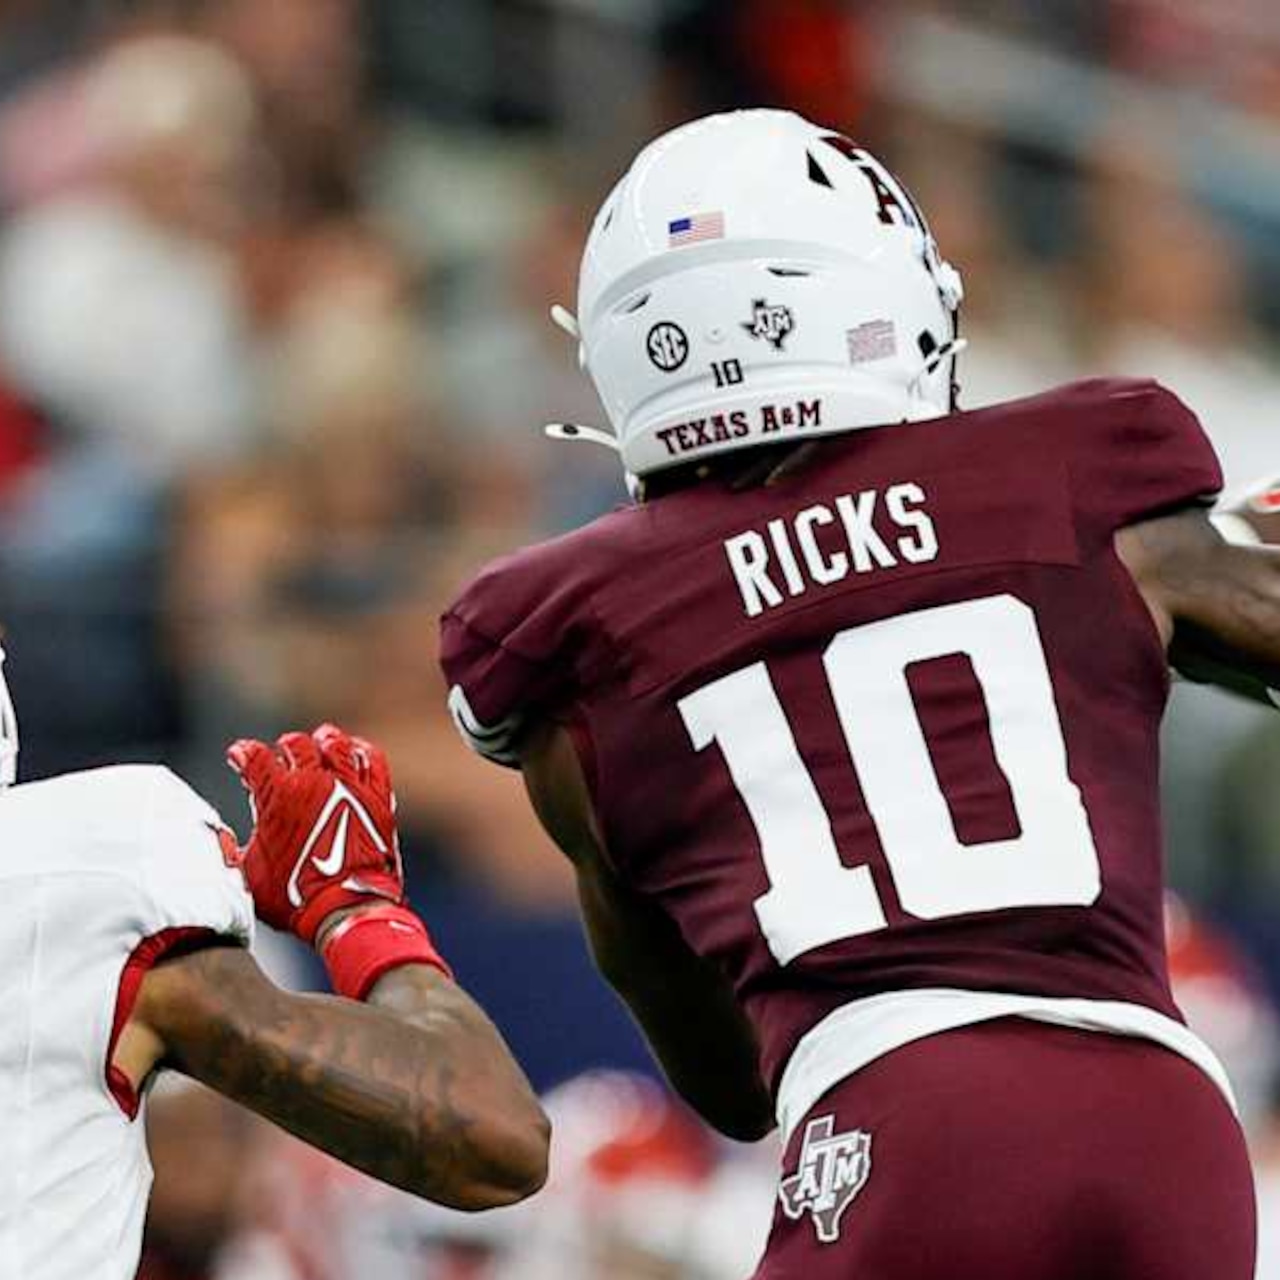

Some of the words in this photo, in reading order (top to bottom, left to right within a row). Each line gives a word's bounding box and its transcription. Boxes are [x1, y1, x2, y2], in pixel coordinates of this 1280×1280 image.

[648, 322, 688, 371] SEC
[710, 358, 744, 388] 10
[656, 411, 749, 455] TEXAS
[760, 399, 821, 433] A&M
[724, 482, 939, 617] RICKS
[676, 593, 1102, 968] 10
